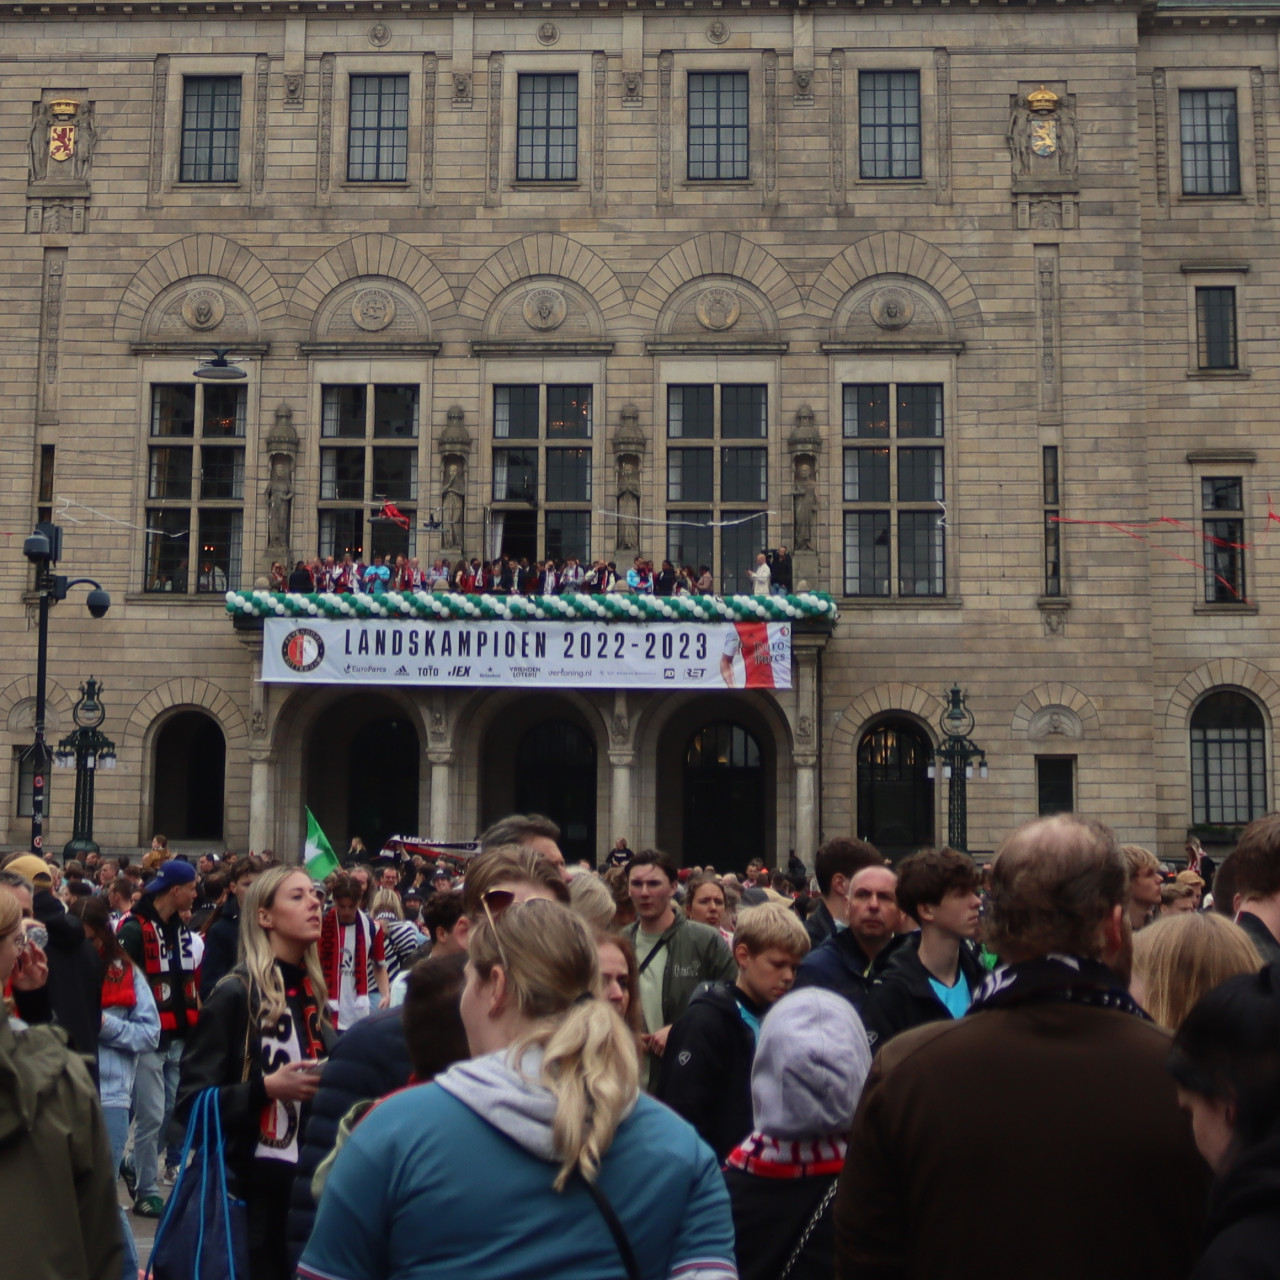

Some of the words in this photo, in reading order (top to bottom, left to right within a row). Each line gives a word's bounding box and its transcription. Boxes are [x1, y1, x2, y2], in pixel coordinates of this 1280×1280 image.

[344, 629, 547, 659] LANDSKAMPIOEN
[563, 631, 708, 659] 2022-2023
[753, 641, 785, 654] Euro
[352, 665, 387, 673] EuroParcs
[417, 665, 439, 677] TOTO
[686, 668, 707, 678] RET
